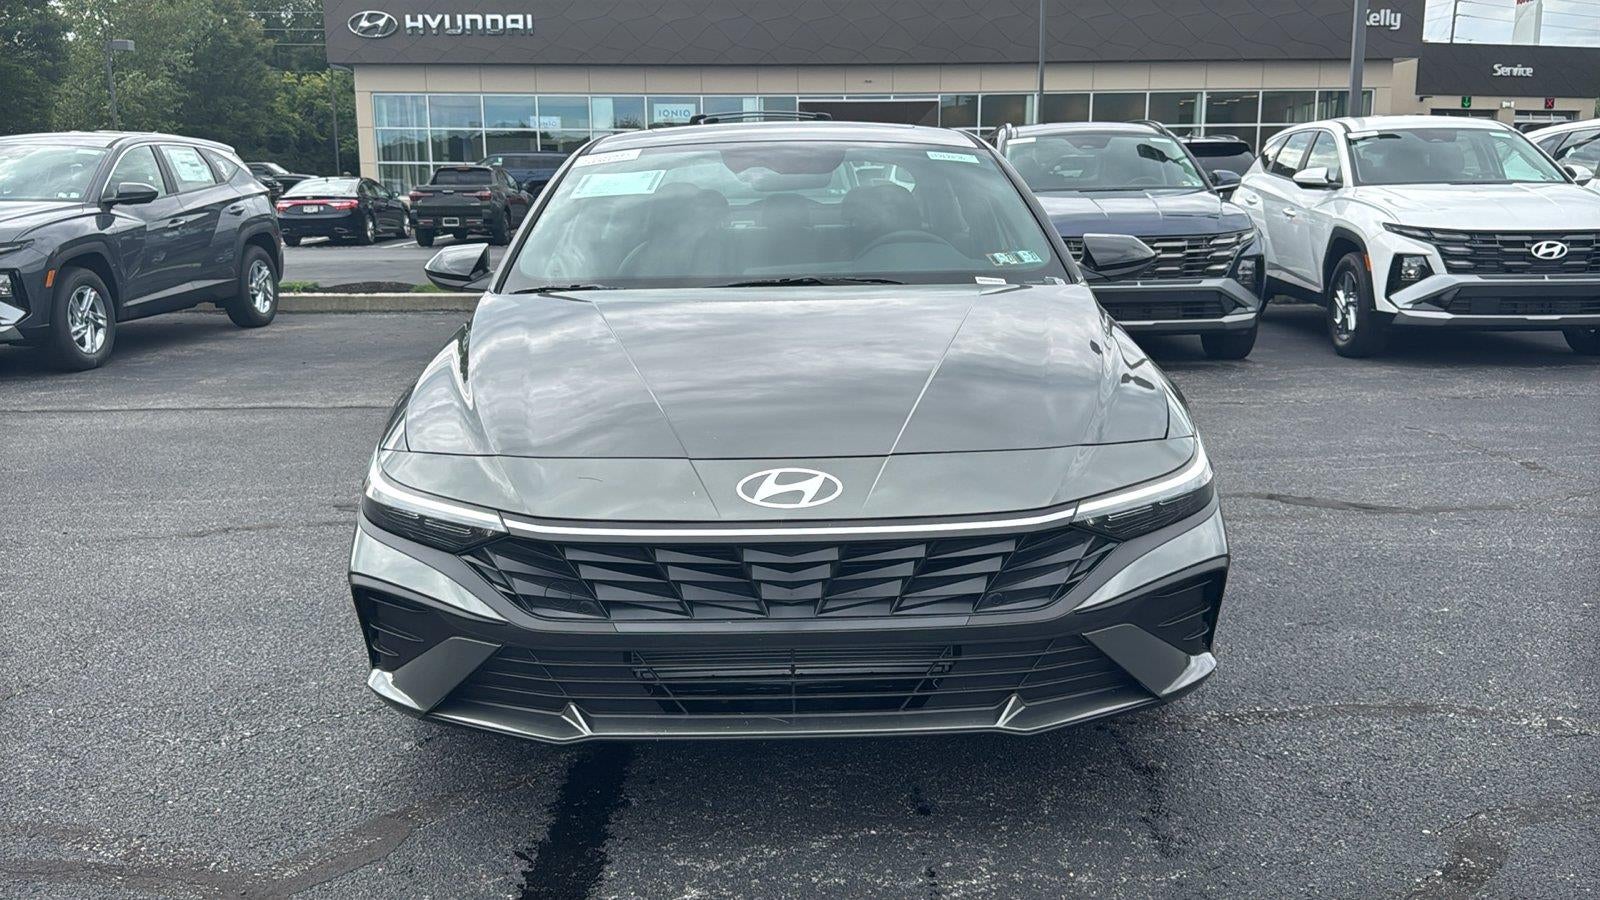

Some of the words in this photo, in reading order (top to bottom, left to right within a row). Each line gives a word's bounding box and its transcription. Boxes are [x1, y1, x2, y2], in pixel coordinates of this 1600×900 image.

[404, 14, 534, 34] HYUNDAI
[1492, 63, 1534, 77] Service
[658, 108, 691, 118] IONIQ
